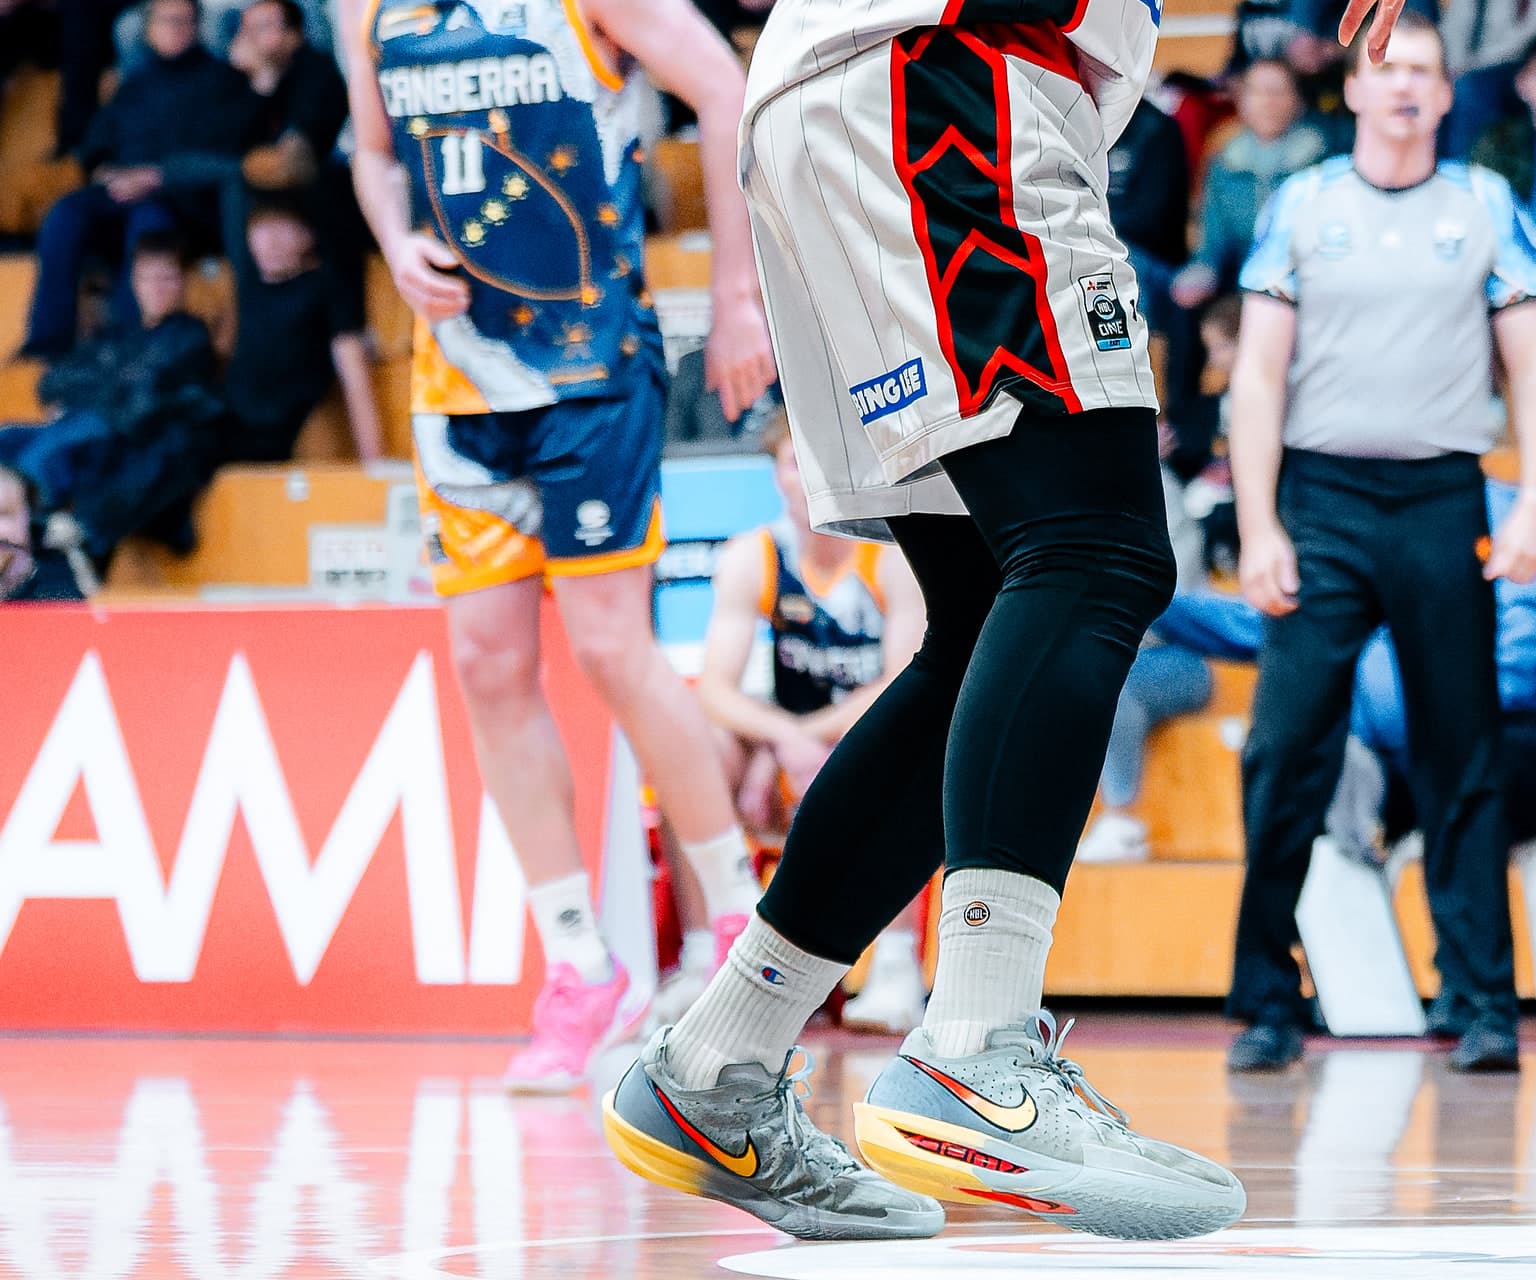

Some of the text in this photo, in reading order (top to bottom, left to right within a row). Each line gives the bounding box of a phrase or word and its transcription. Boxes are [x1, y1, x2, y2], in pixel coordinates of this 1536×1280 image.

[379, 52, 563, 118] CANBERRA
[441, 128, 487, 196] 11
[1098, 321, 1124, 336] ONE
[969, 908, 984, 920] NBL
